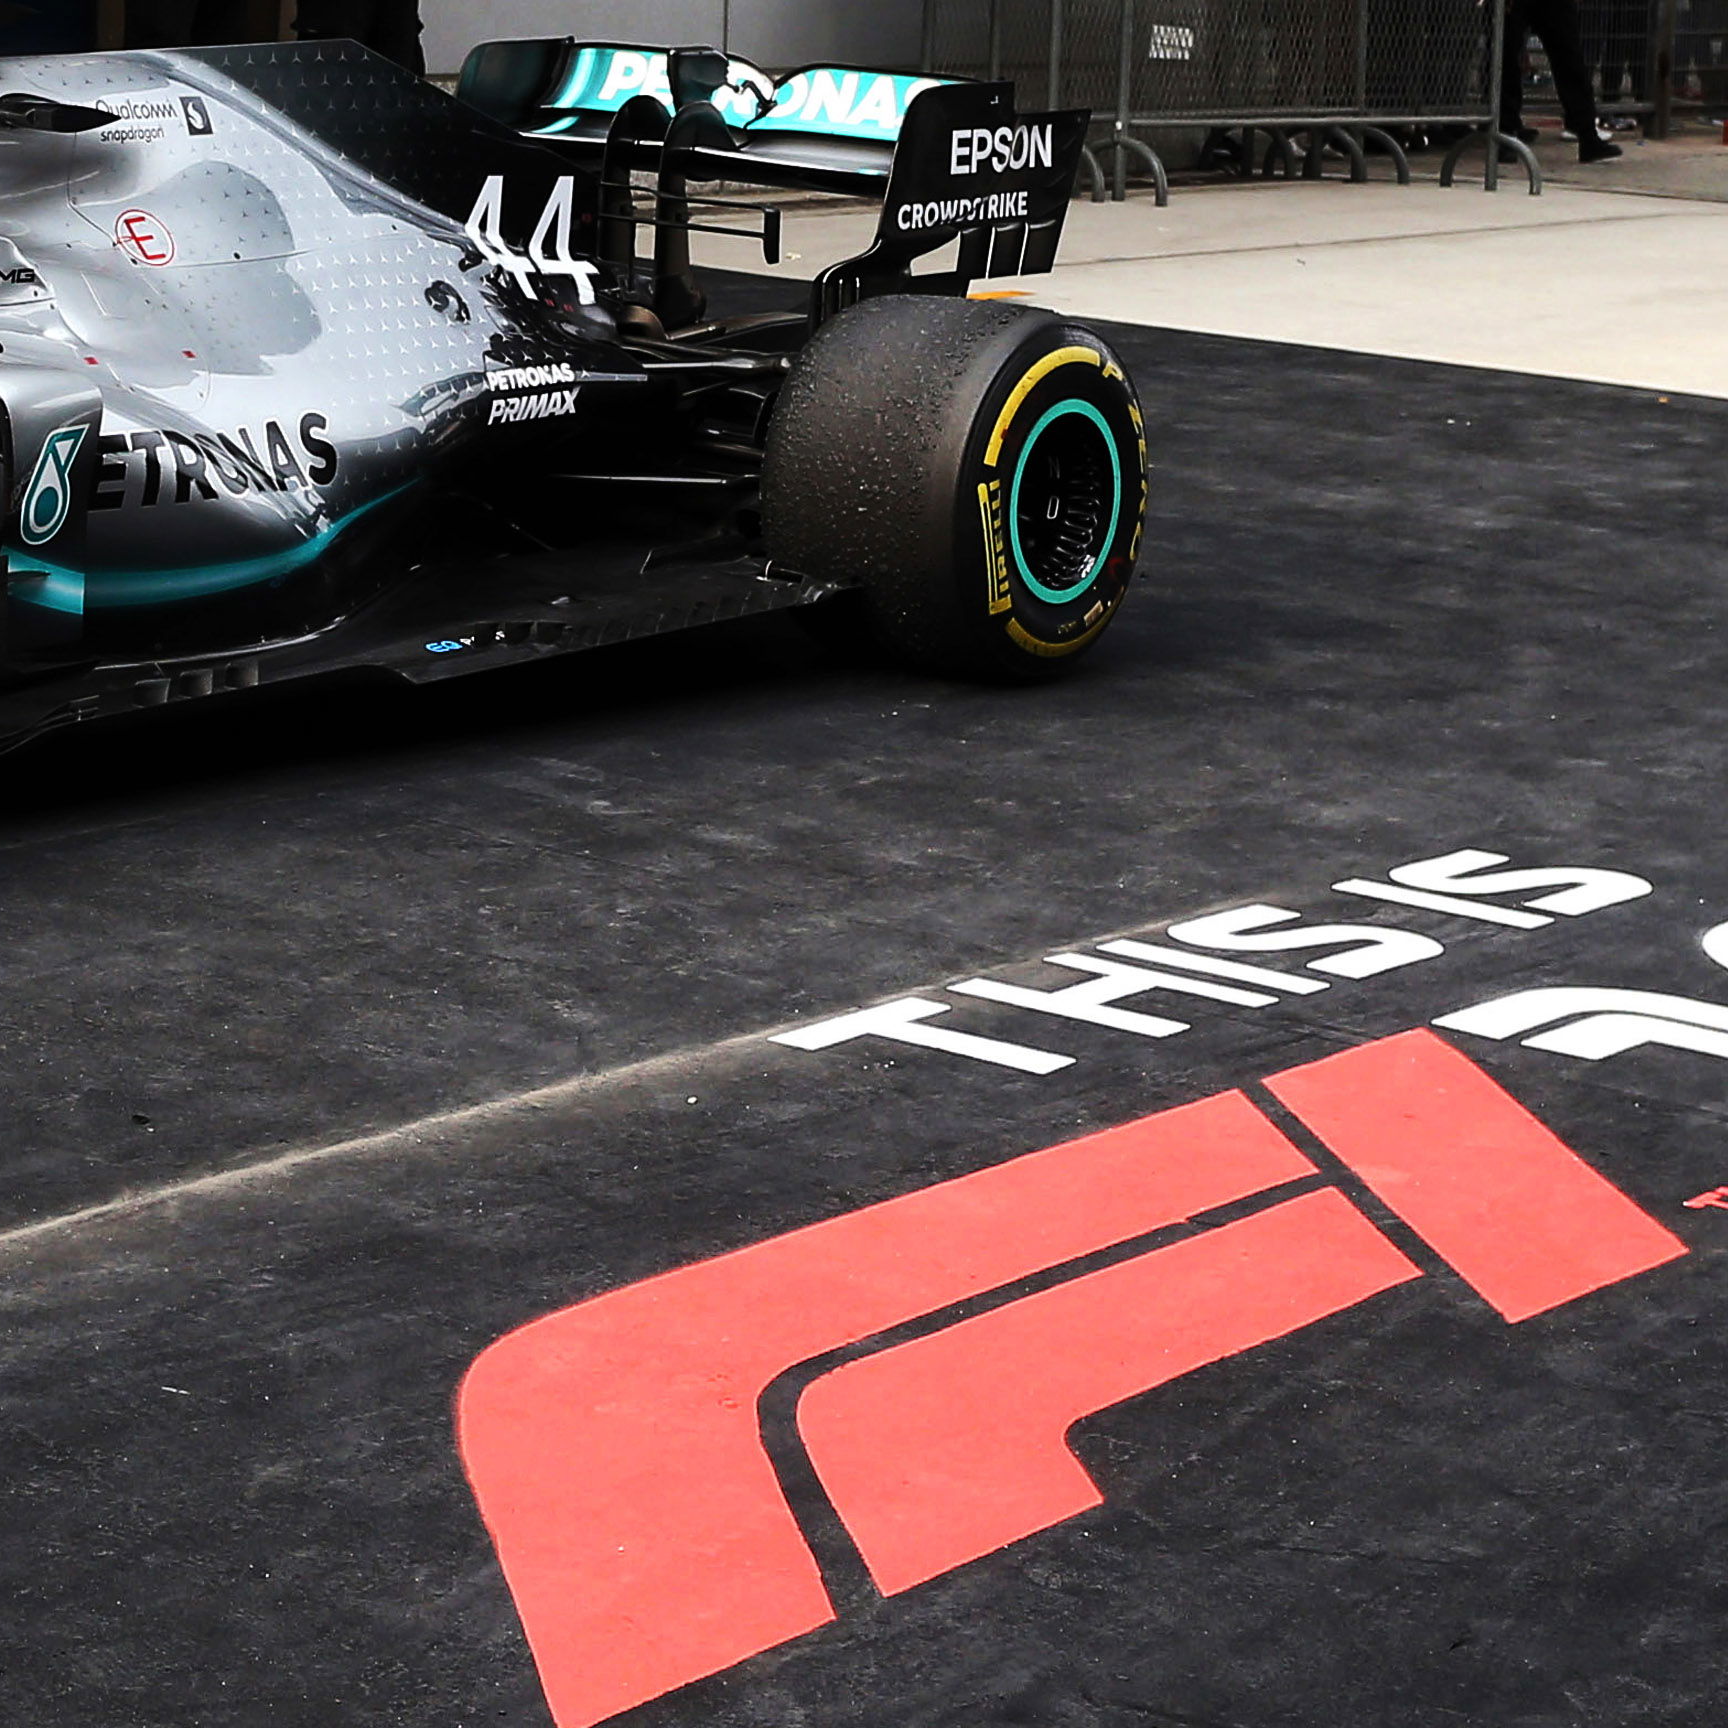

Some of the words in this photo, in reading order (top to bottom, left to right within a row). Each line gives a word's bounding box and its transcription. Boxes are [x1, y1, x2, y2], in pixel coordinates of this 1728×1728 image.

[950, 123, 1053, 175] EPSON
[897, 191, 1028, 231] CROWDSTRIKE
[464, 175, 600, 306] 44
[487, 363, 576, 392] PETRONAS
[487, 385, 581, 426] PRIMAX
[89, 412, 338, 511] ETRONAS
[766, 903, 1445, 1075] THIS
[1331, 848, 1653, 929] IS
